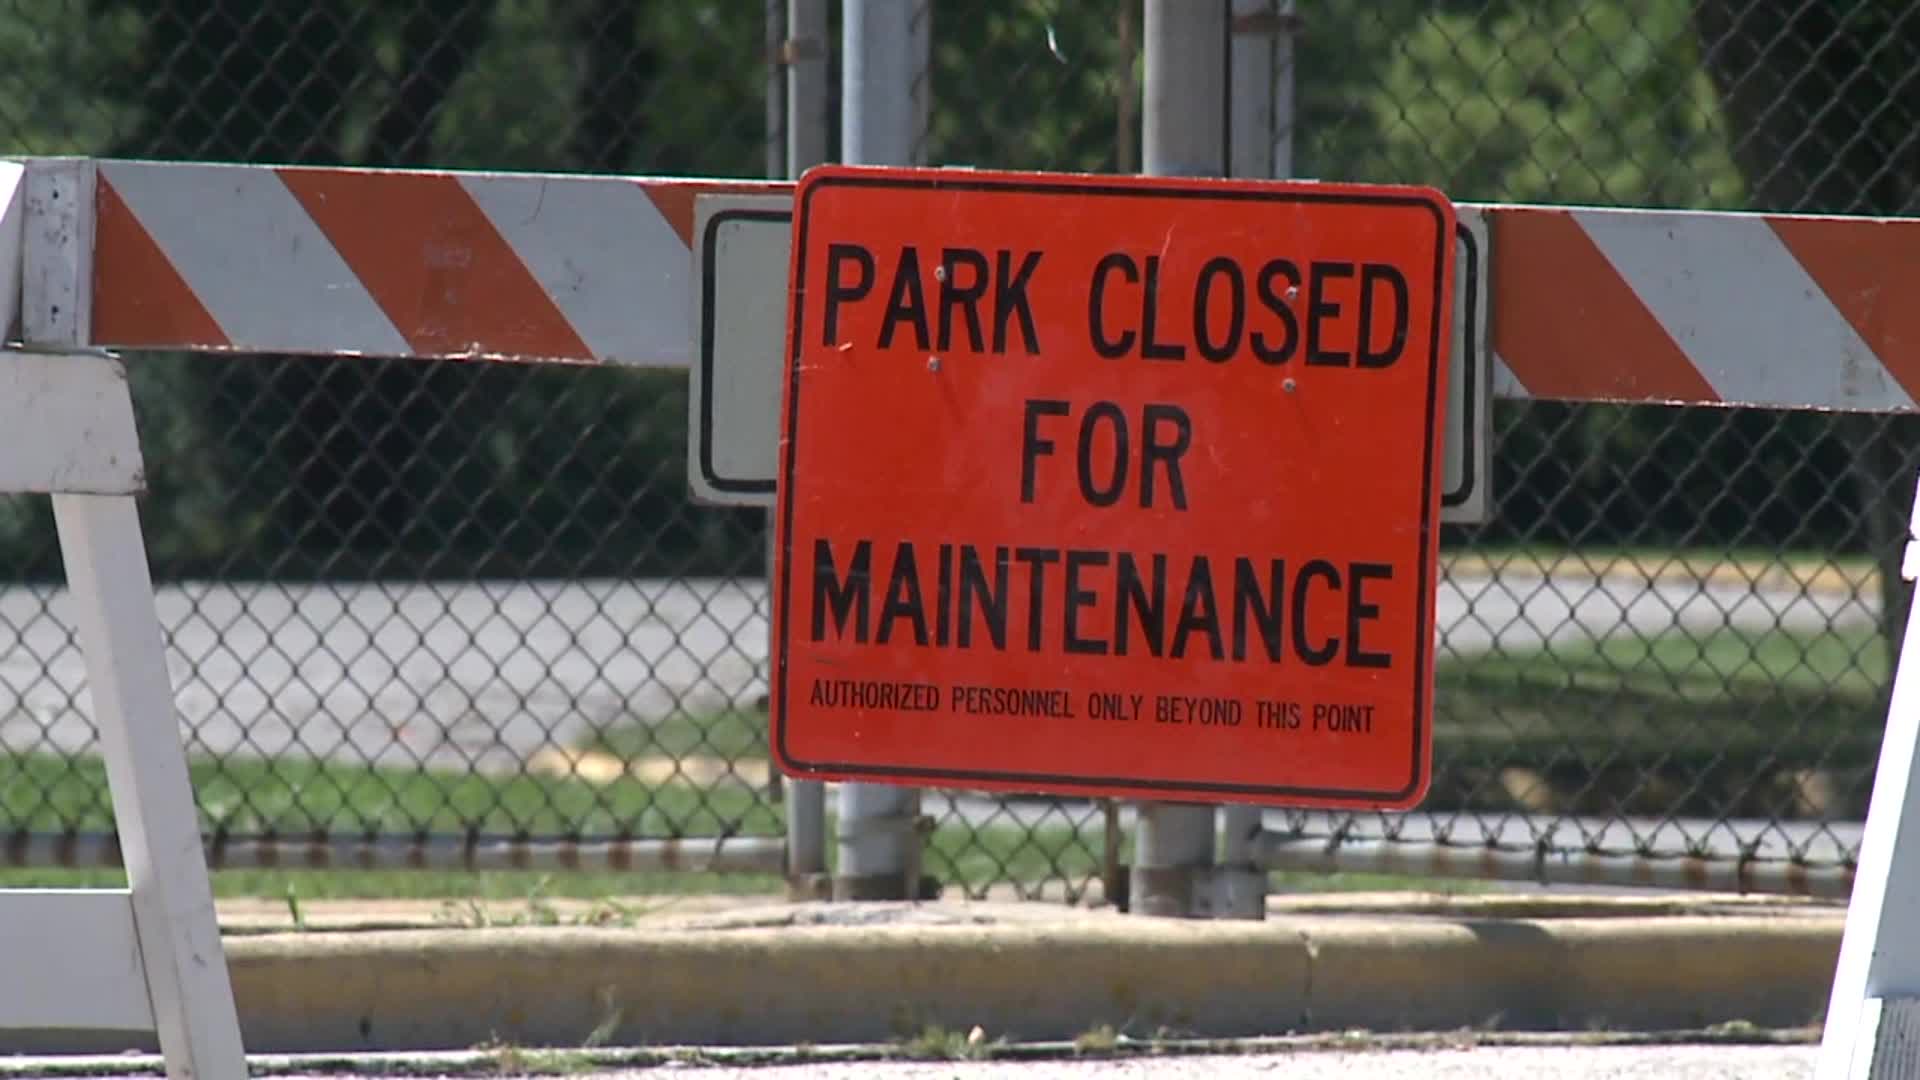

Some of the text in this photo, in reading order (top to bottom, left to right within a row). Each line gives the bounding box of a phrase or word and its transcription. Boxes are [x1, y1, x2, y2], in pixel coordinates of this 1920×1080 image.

[822, 243, 1412, 370] PARK CLOSED
[1020, 399, 1193, 511] FOR
[811, 537, 1396, 670] MAINTENANCE
[810, 678, 1376, 734] AUTHORIZED PERSONNEL ONLY BEYOND THIS POINT
